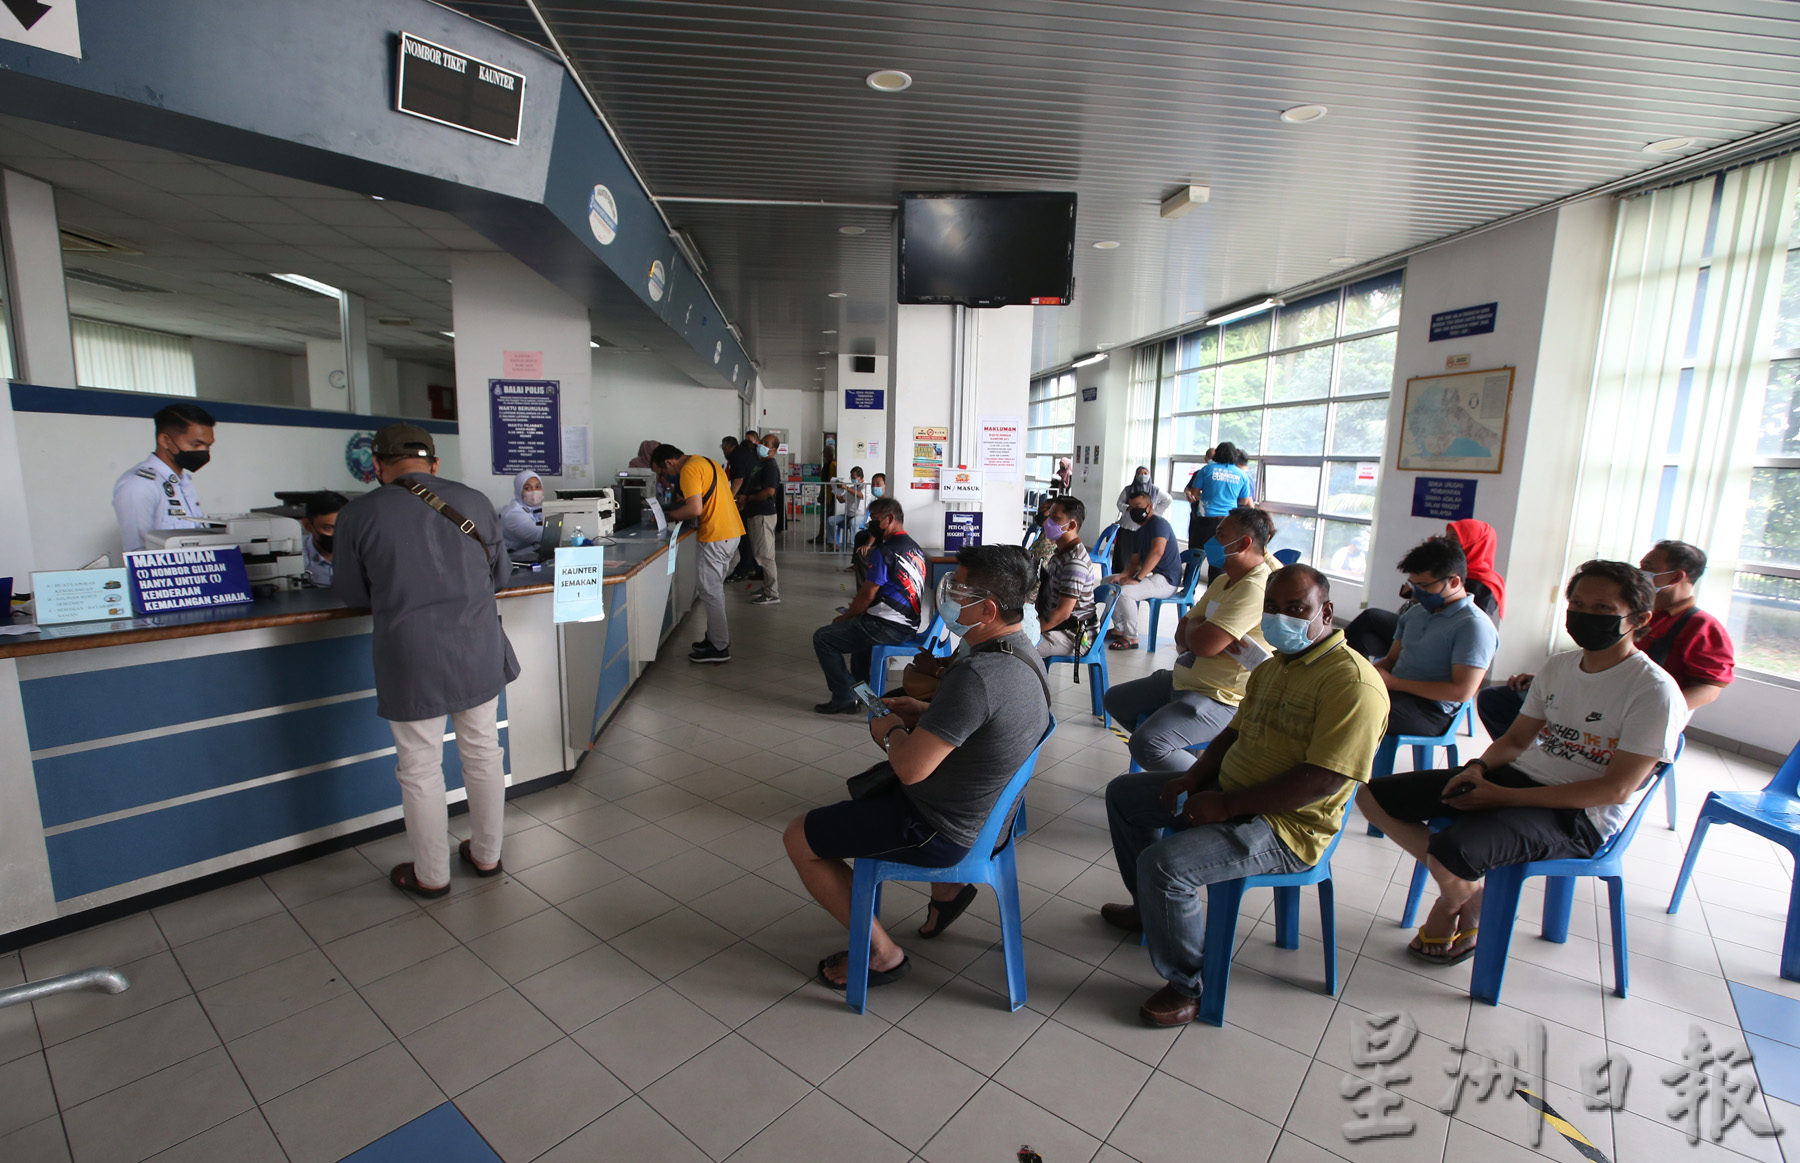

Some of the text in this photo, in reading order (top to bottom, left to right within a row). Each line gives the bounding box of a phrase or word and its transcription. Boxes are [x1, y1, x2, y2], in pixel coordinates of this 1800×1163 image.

[404, 39, 515, 91] NOMBOR TIKET KAUNTER
[503, 385, 545, 395] BALAI POLIS
[132, 550, 217, 568] MAKLUMAN
[136, 563, 227, 579] (1) NOMBOR GILIRAN
[561, 566, 598, 576] KAUNTER
[138, 573, 222, 590] HANYA UNTUK (1)
[560, 578, 597, 588] SEMAKAN
[141, 586, 202, 601] KENDERAAN
[144, 592, 250, 611] KEMALANGAN SAHAJA.
